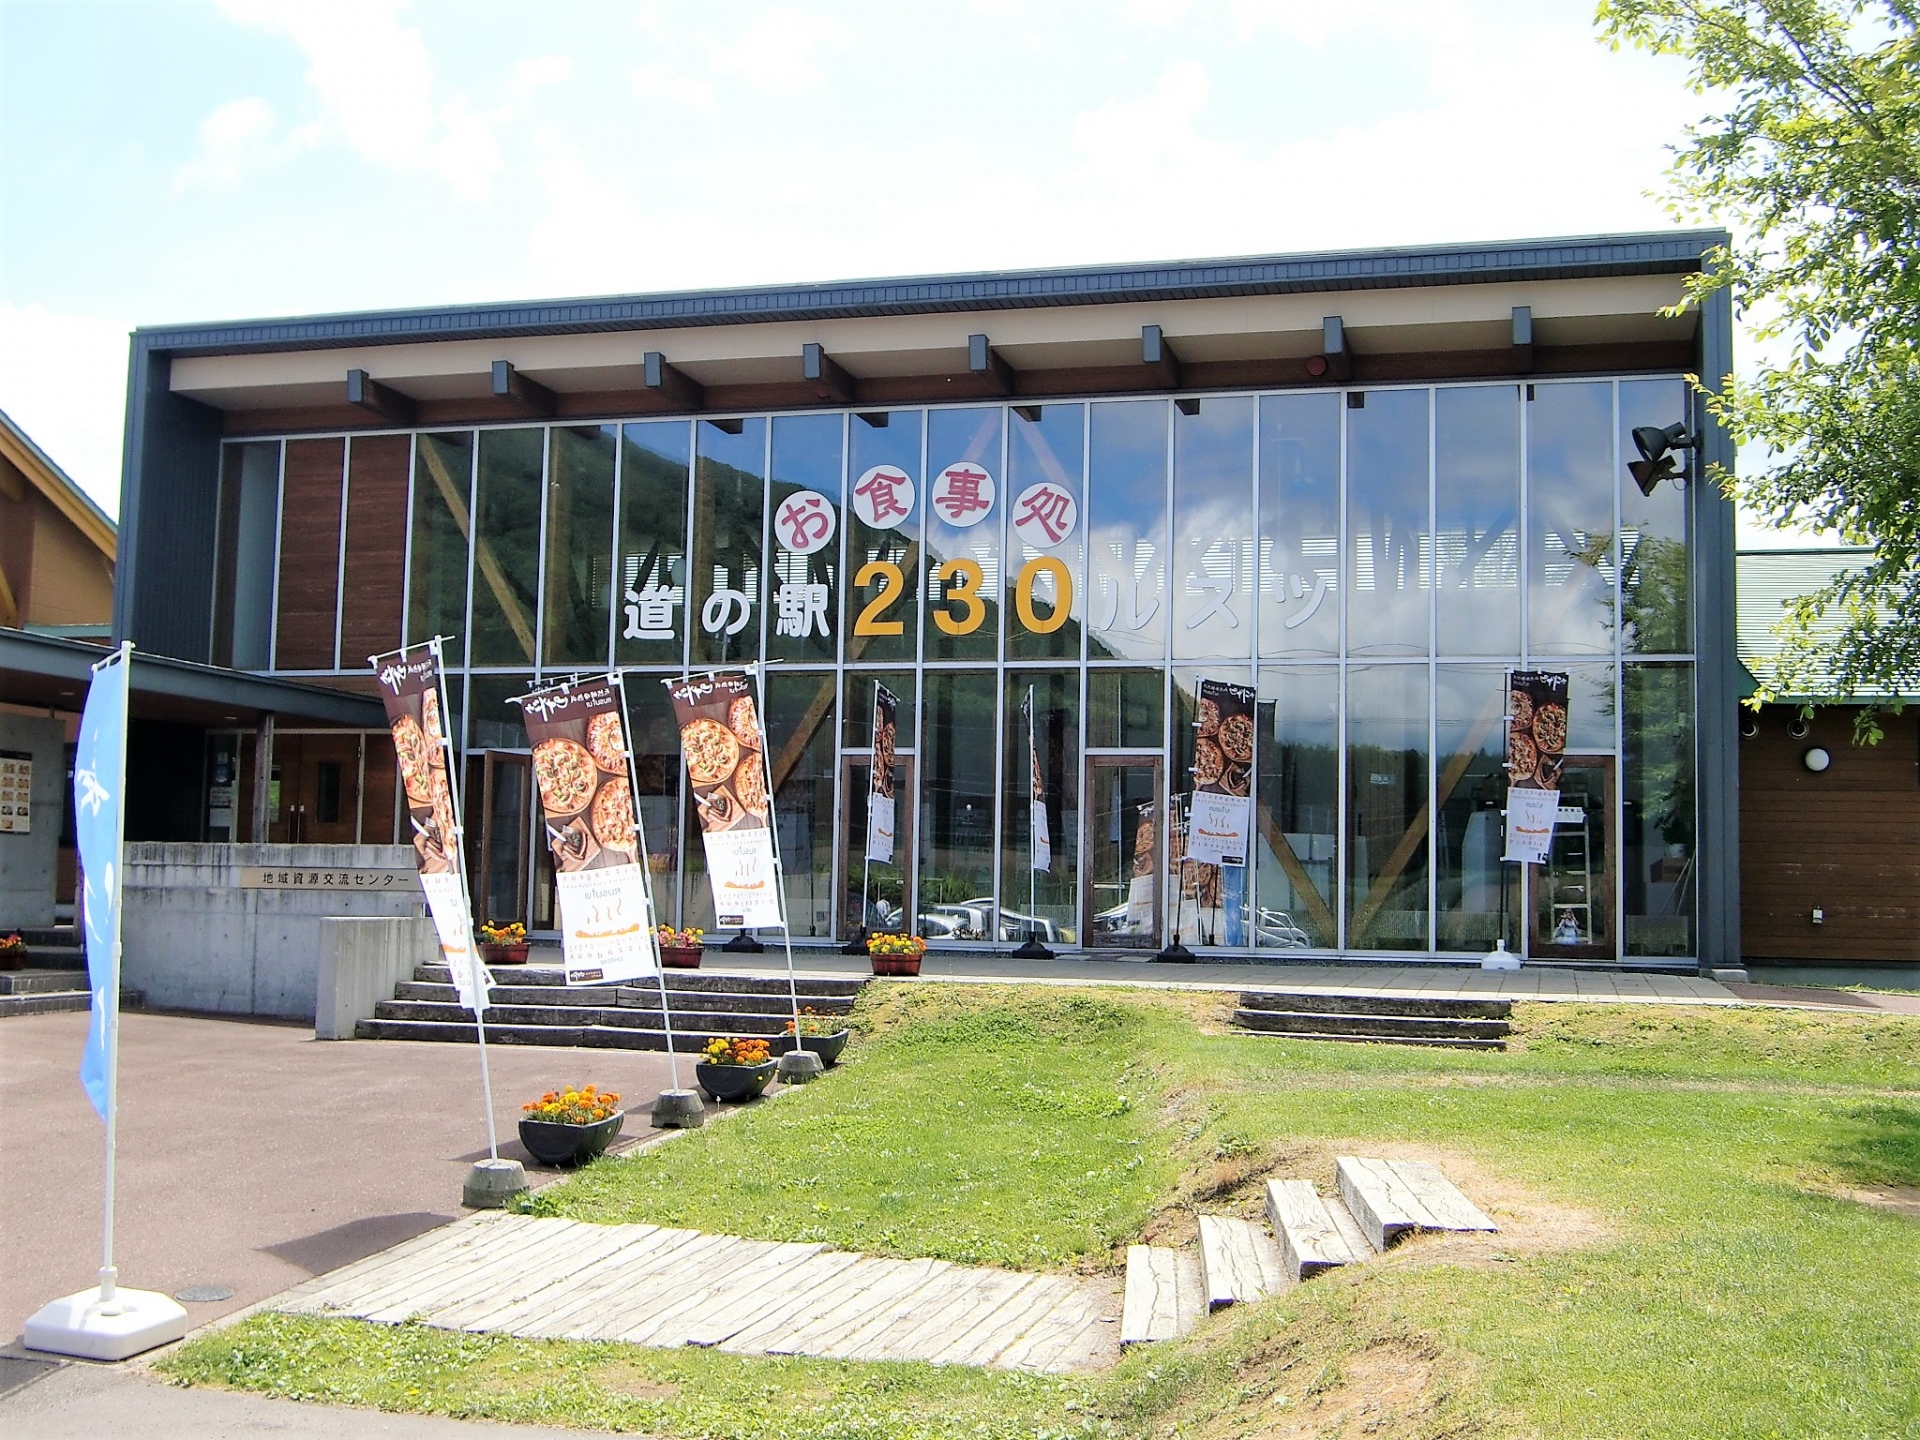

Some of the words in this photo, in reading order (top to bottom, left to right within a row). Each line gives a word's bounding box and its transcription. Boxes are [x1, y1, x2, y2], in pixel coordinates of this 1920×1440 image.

[780, 468, 1076, 548] お食事処
[263, 872, 409, 886] 地域資源交流センター
